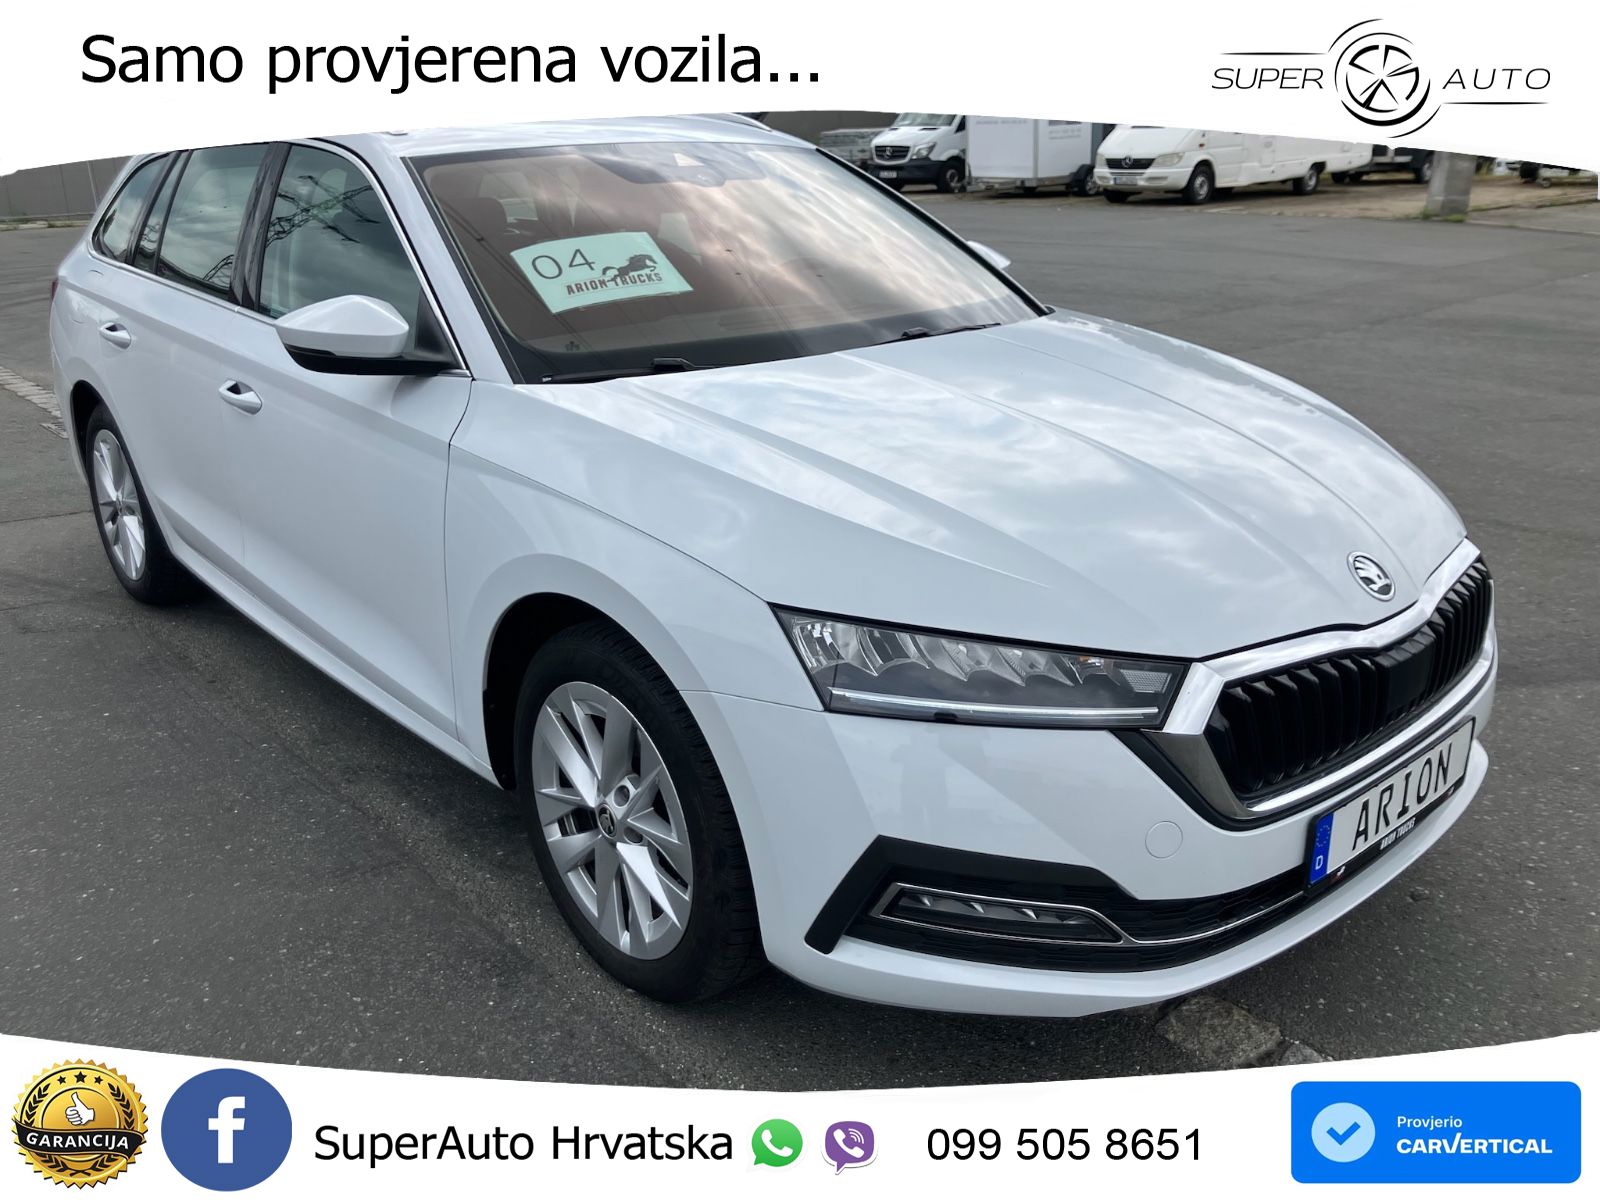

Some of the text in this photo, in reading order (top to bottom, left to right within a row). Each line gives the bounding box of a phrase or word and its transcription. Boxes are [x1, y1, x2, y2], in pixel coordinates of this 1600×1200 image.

[531, 248, 596, 280] 04
[566, 272, 663, 296] ARION TRUCKS
[1352, 742, 1453, 850] ARION
[1315, 855, 1324, 870] D
